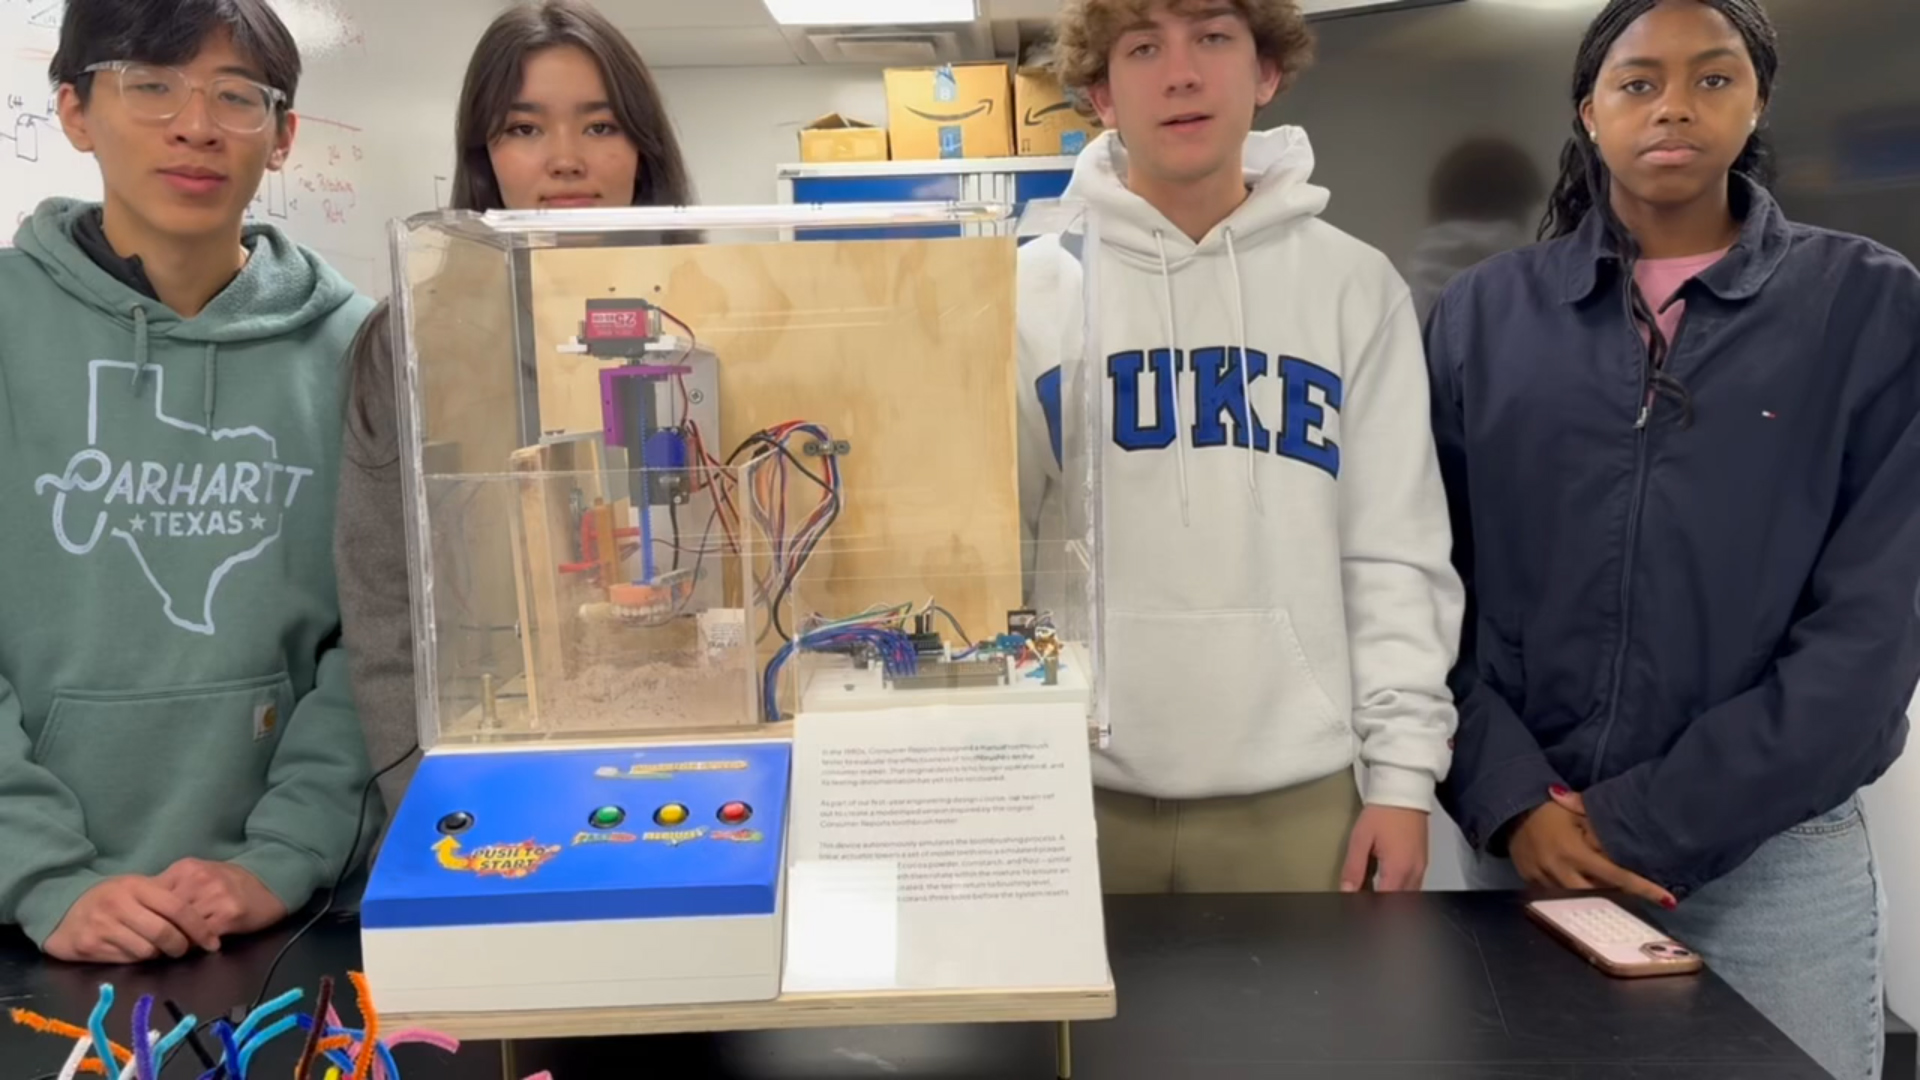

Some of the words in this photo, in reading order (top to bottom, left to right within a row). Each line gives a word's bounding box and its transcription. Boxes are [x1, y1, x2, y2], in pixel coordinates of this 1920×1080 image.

[35, 449, 313, 554] CARHARTT
[150, 511, 243, 536] TEXAS
[471, 847, 520, 860] PUSH
[524, 846, 546, 858] TO
[479, 859, 535, 871] START
